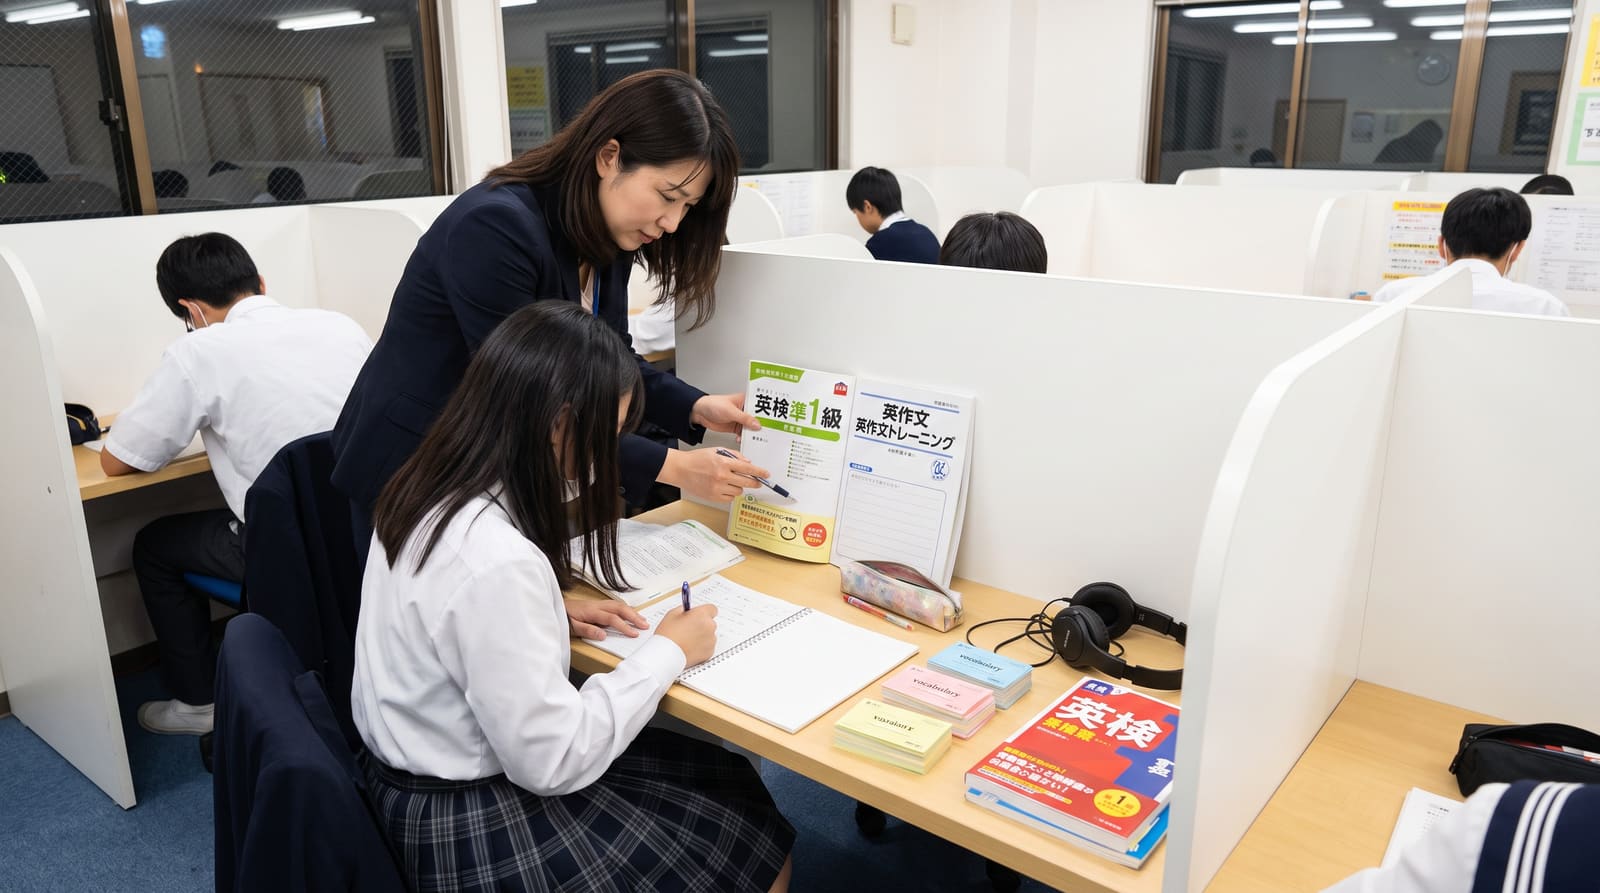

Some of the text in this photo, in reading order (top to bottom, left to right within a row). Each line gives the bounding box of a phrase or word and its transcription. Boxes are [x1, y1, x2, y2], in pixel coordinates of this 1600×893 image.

[755, 394, 842, 429] 英検準1級
[882, 403, 930, 428] 英作文
[855, 417, 956, 450] 英作文トレーニング
[913, 678, 960, 698] vocabulary
[1055, 695, 1163, 748] 英検
